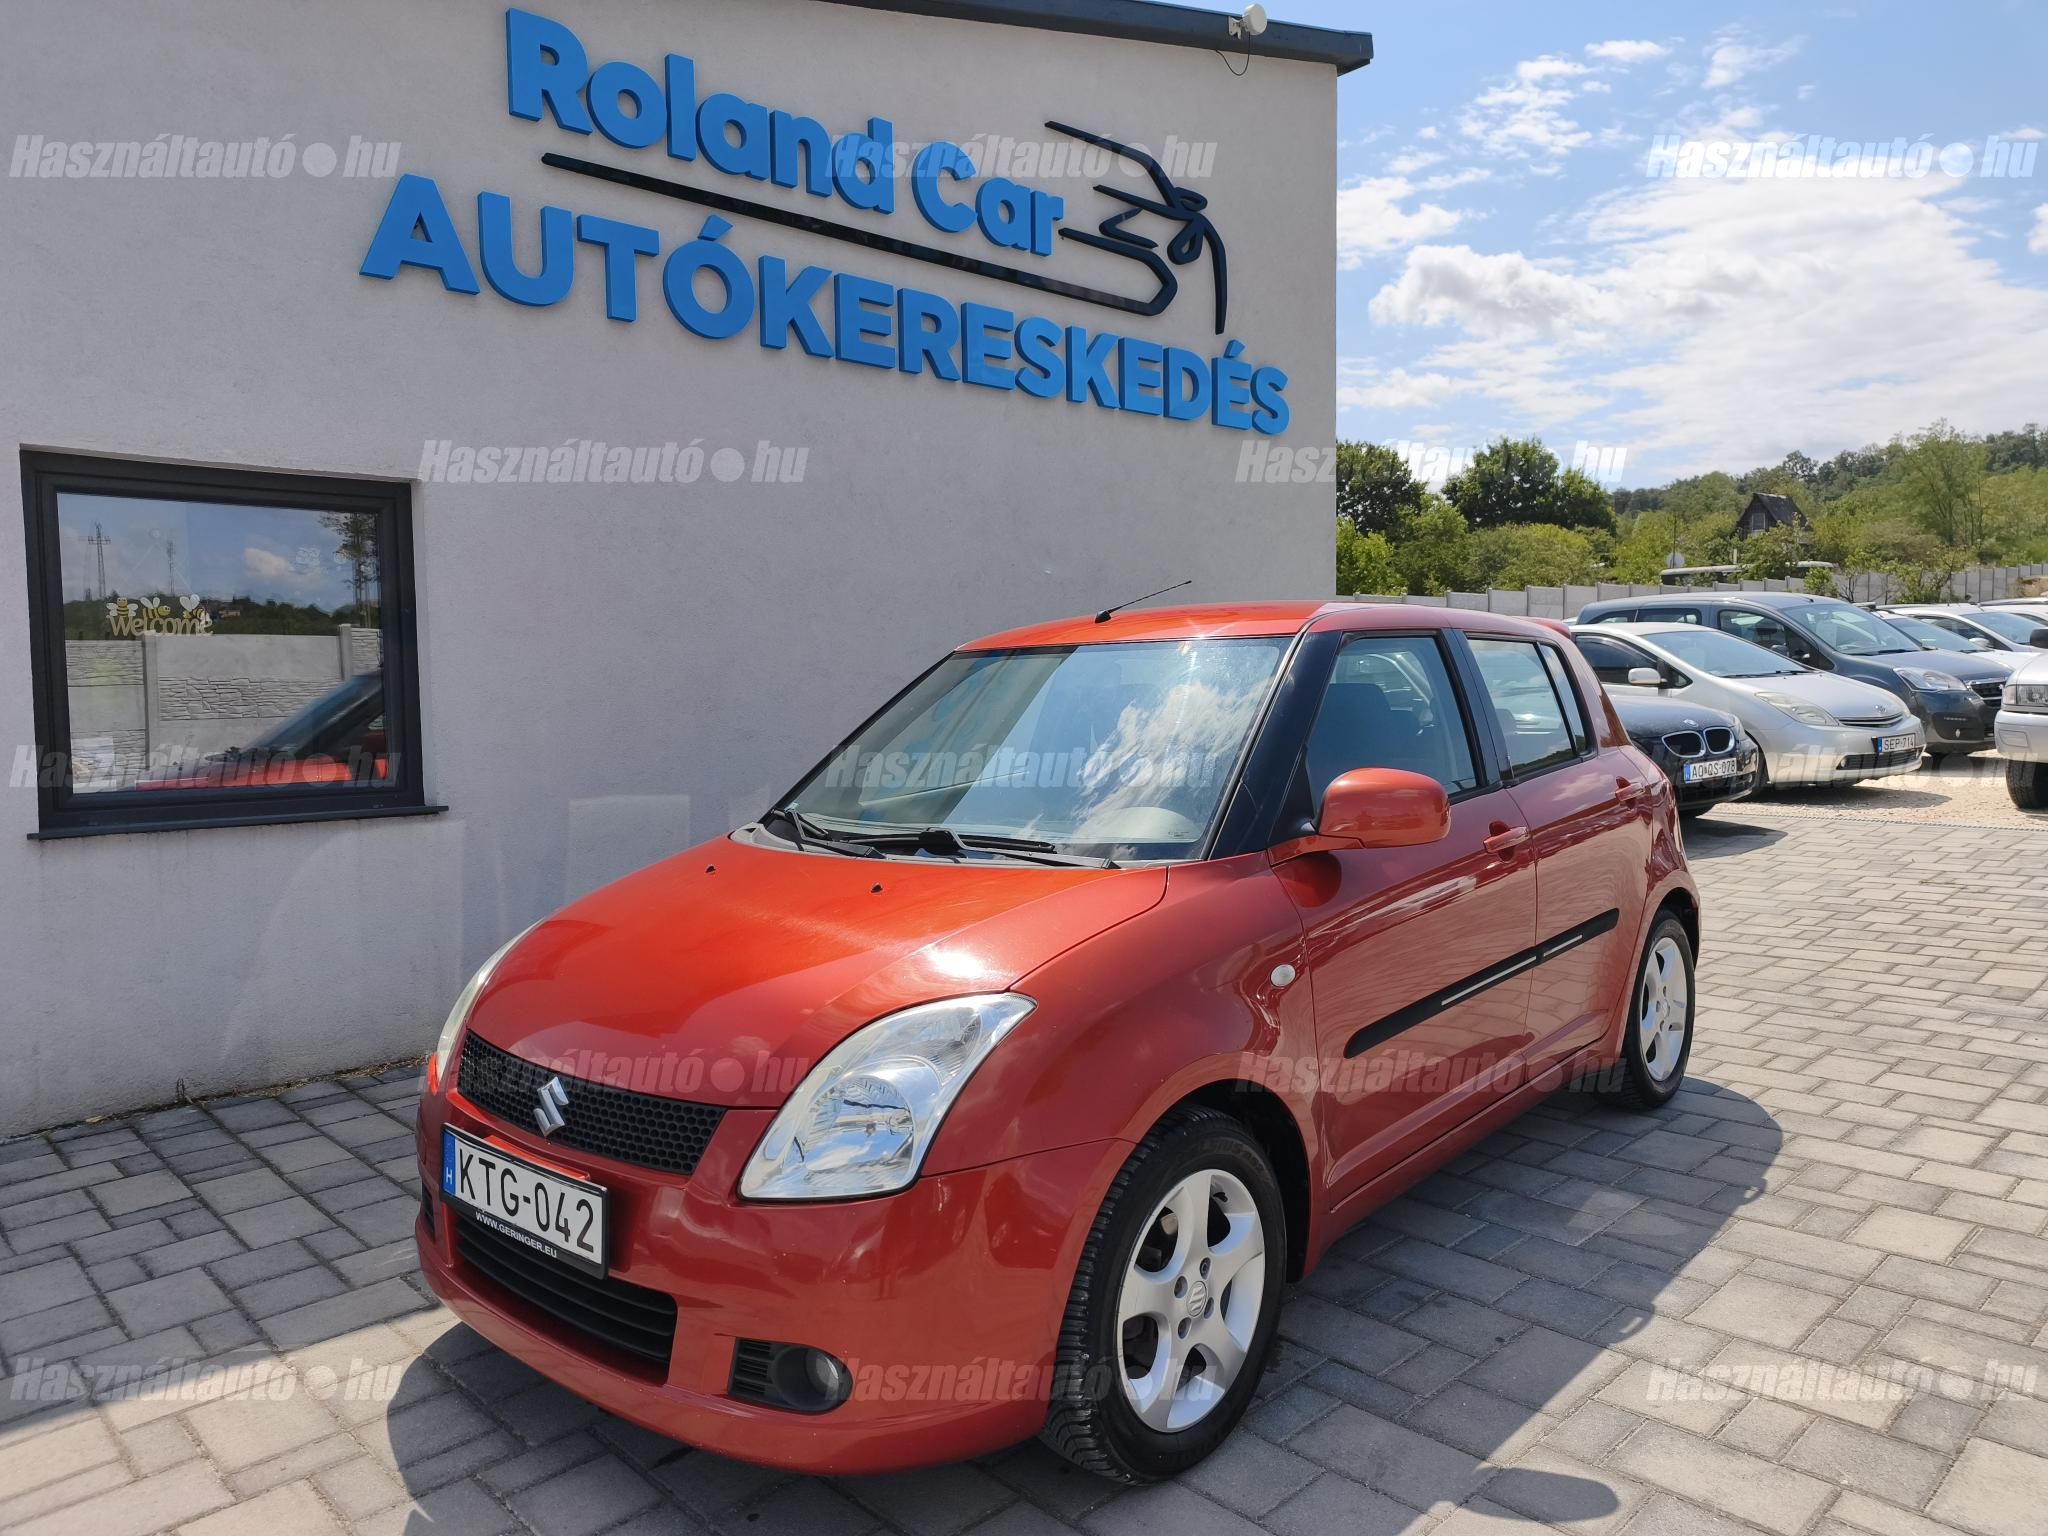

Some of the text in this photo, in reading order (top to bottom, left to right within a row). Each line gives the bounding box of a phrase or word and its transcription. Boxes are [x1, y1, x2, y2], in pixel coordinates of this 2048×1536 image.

[506, 8, 1064, 256] Roland Car
[360, 173, 1290, 435] AUTÓKERESKEDÉS
[106, 614, 214, 637] Welcome
[459, 1148, 594, 1254] KTG-042
[475, 1211, 558, 1259] WWW.GERINGER.EU
